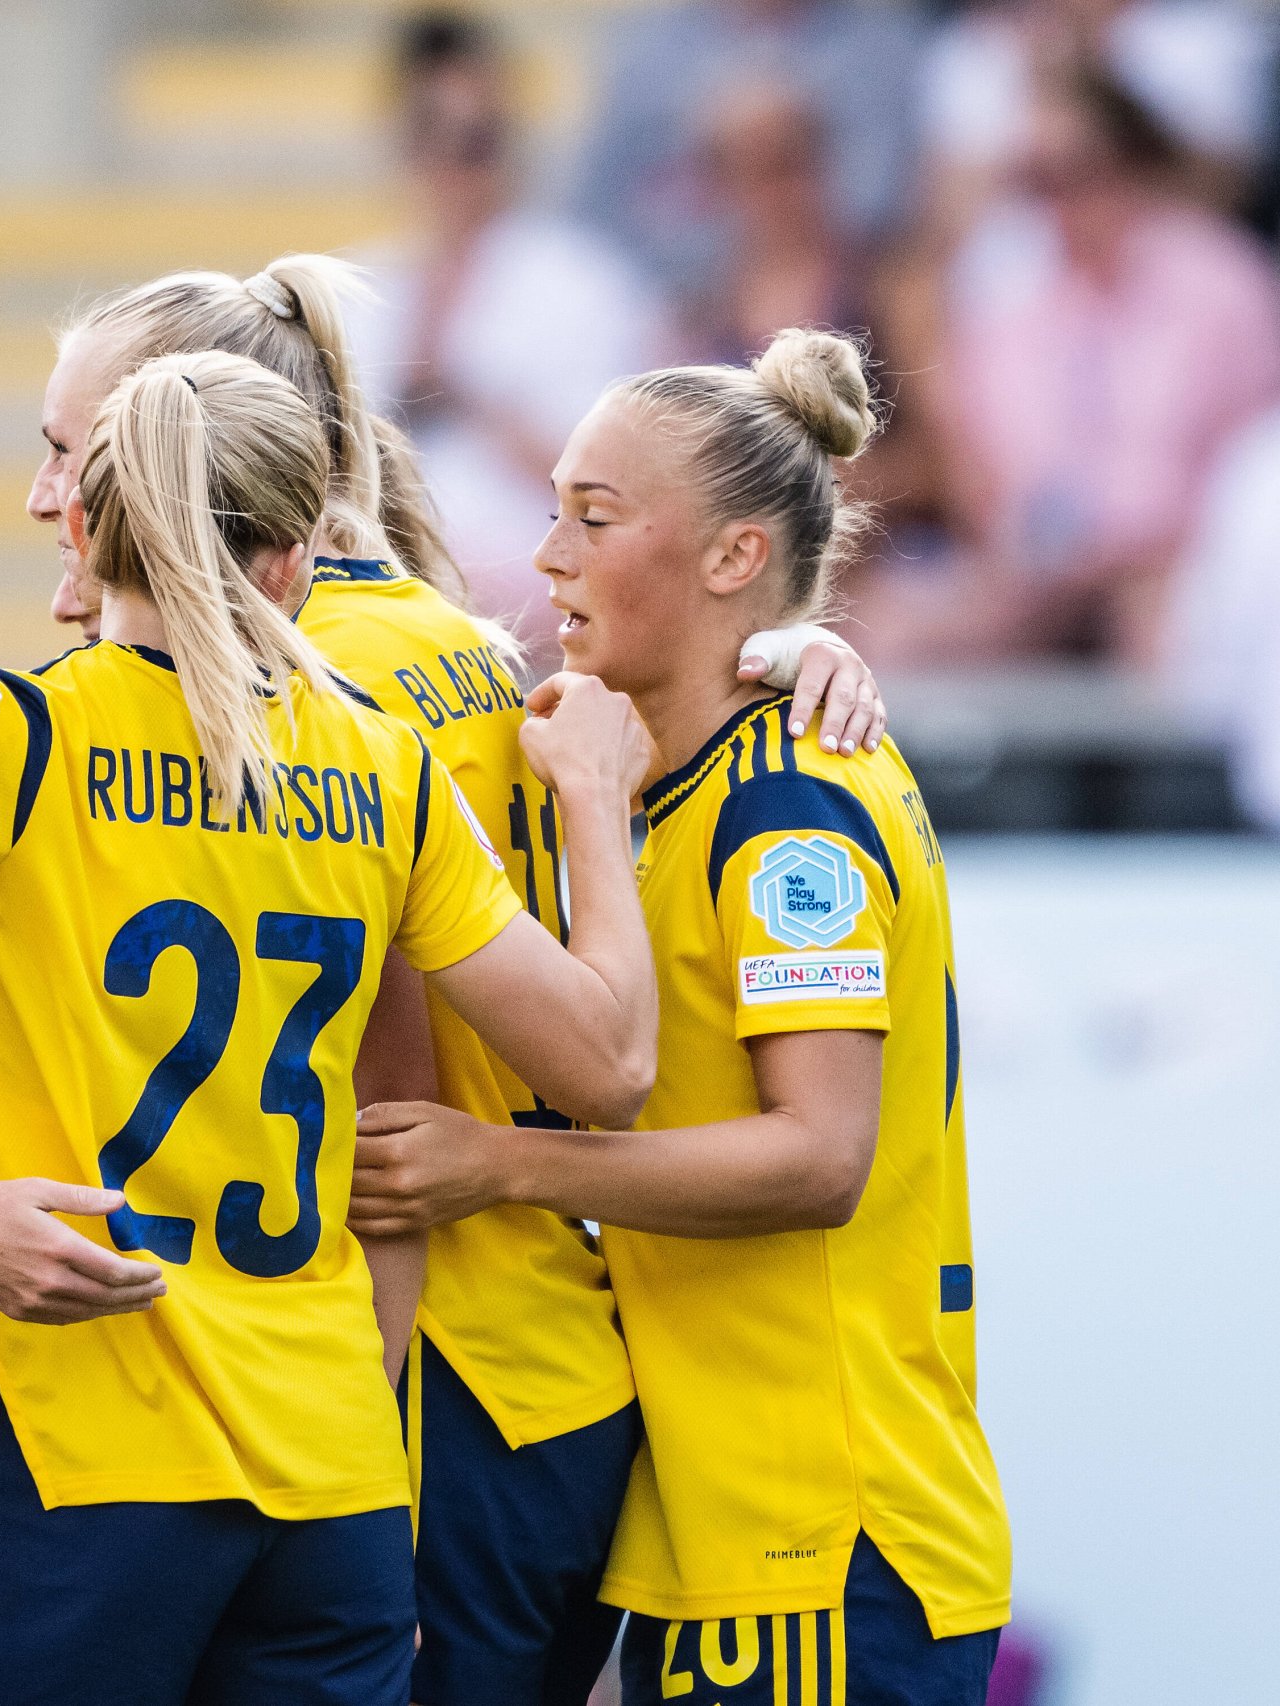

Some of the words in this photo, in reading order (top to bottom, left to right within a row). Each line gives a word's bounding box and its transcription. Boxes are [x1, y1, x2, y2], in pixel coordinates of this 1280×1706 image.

[785, 874, 806, 886] We
[787, 887, 815, 902] Play
[788, 900, 832, 914] Strong
[744, 958, 776, 971] UEFA
[745, 965, 881, 988] FOUNDATION
[840, 984, 852, 995] for
[852, 984, 881, 993] children
[97, 898, 367, 1279] 23
[765, 1549, 818, 1560] PRIMEBLUE
